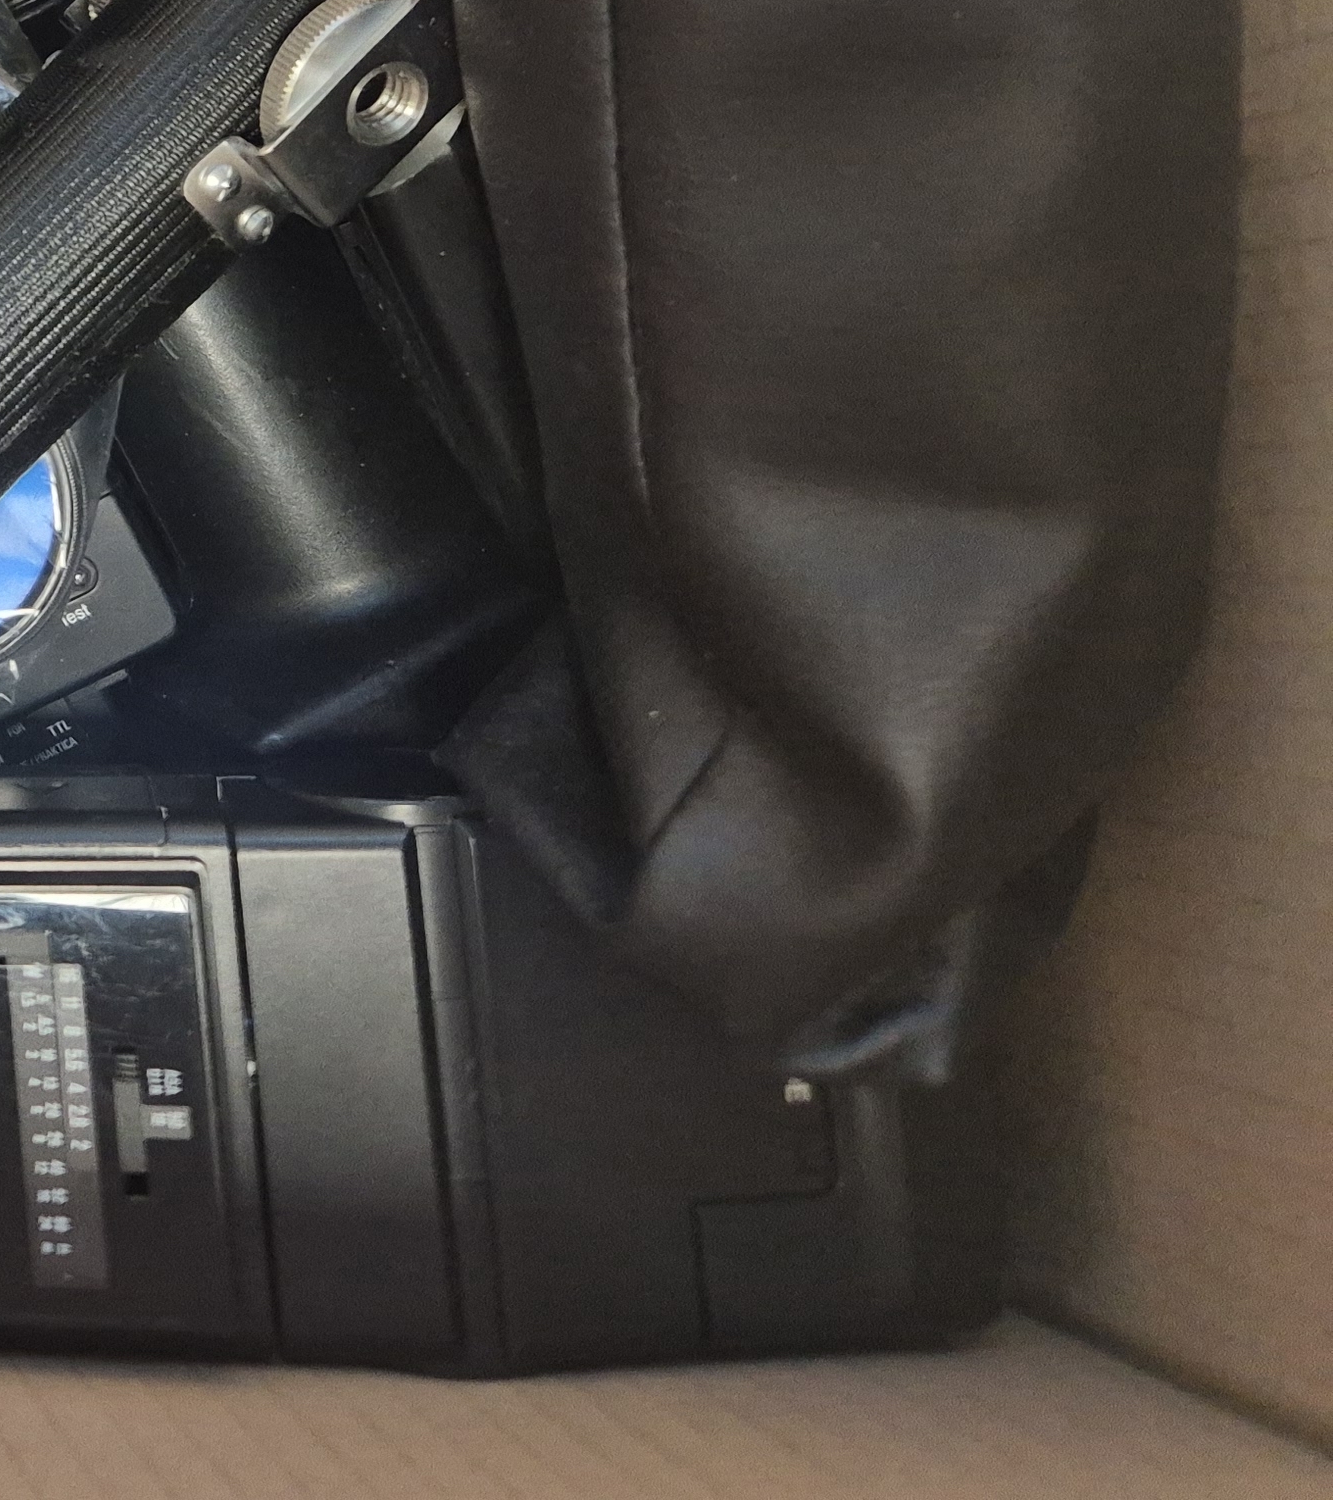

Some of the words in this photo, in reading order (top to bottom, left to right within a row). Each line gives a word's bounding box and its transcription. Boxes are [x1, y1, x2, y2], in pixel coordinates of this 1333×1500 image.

[46, 719, 72, 737] TTL
[67, 1082, 89, 1093] 4
[70, 1139, 92, 1150] 2
